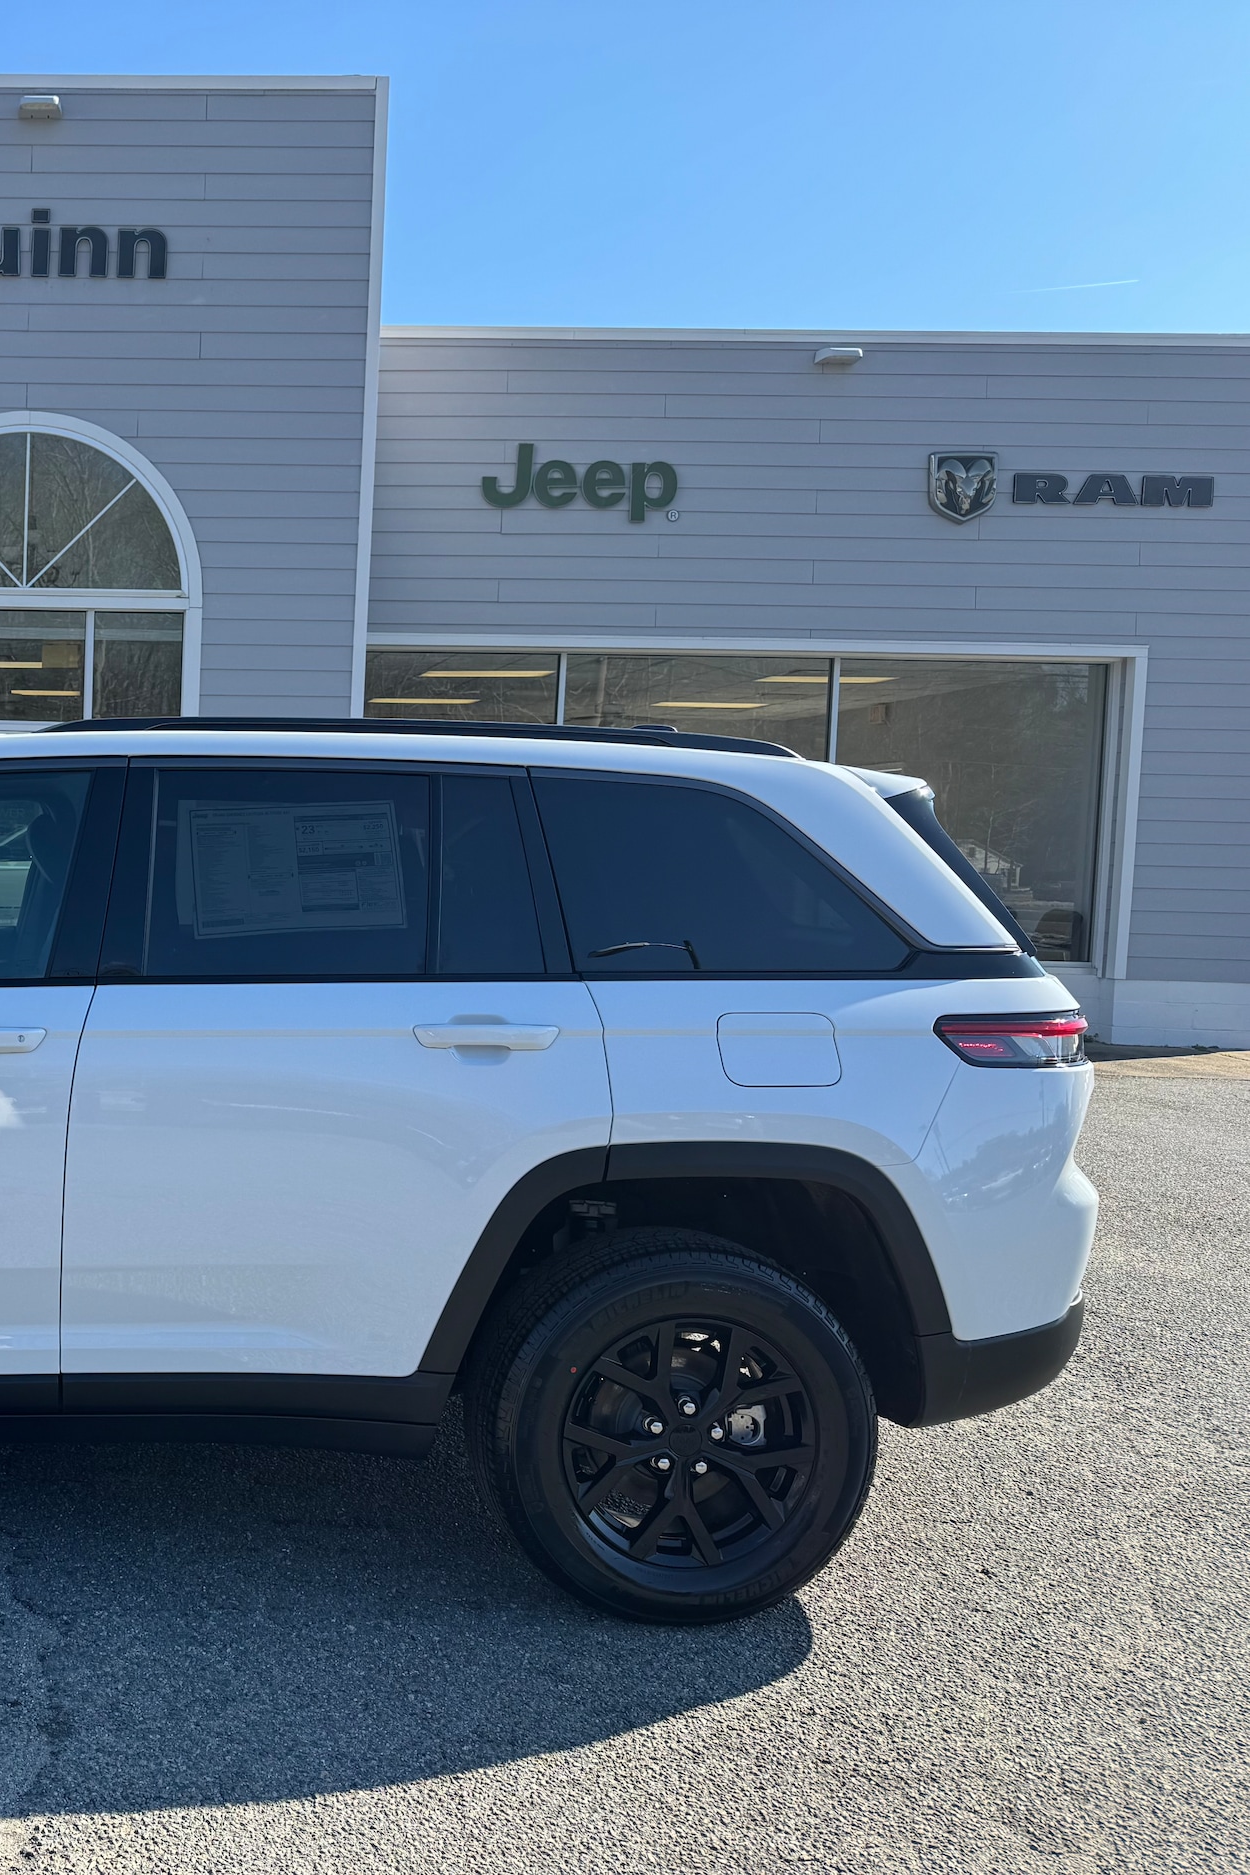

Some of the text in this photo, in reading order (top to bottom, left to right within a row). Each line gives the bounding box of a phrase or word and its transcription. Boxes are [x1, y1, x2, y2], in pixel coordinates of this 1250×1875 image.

[481, 443, 678, 523] Jeep
[1013, 472, 1215, 507] RAM
[301, 825, 315, 835] 23
